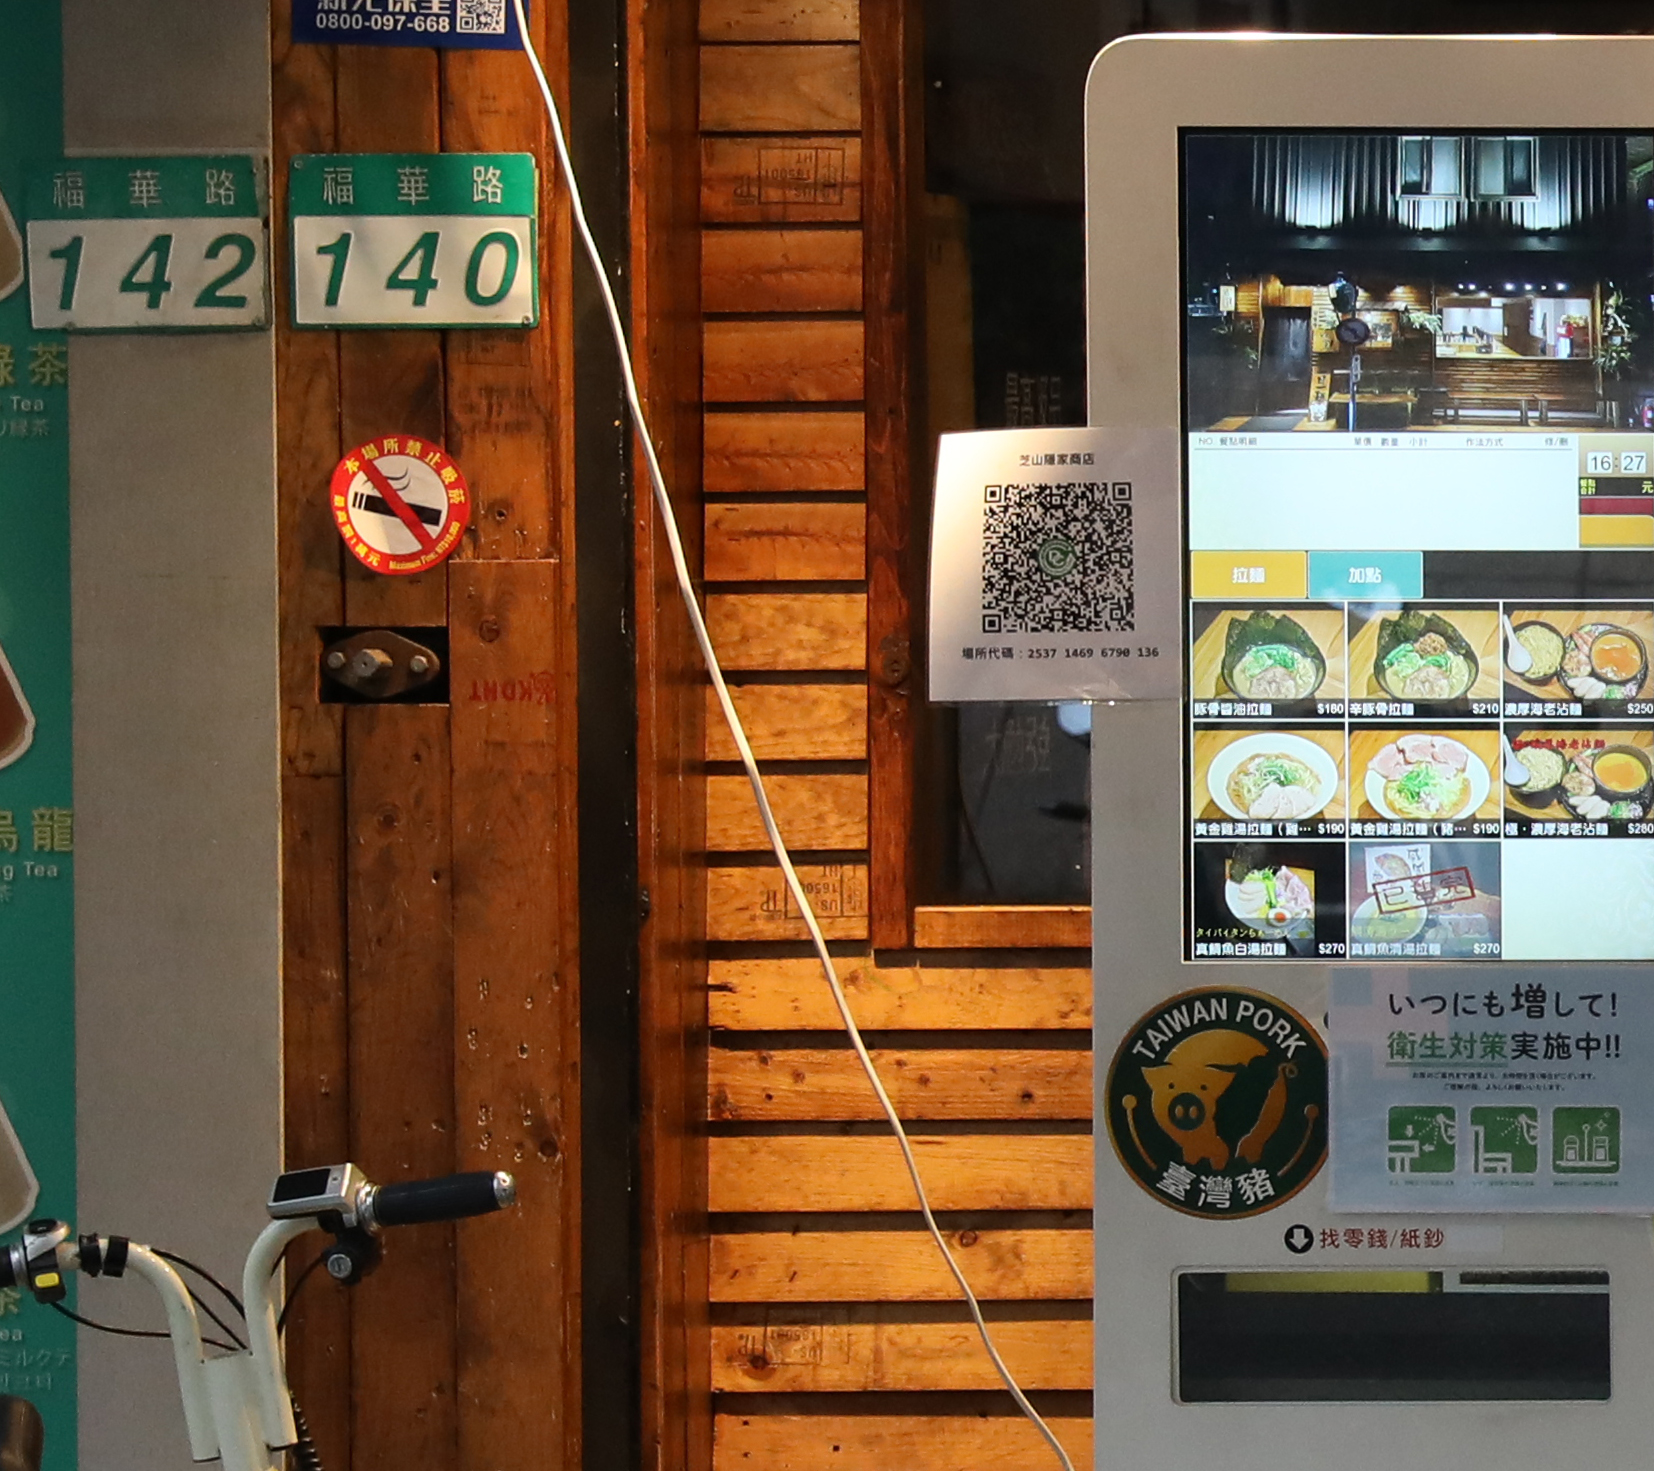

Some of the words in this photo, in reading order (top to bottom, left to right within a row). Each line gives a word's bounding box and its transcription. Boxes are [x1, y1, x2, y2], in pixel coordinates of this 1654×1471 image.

[315, 13, 450, 33] 0800-097-668
[53, 171, 237, 208] 福華路
[321, 165, 504, 206] 福華路
[48, 232, 257, 311] 142
[315, 231, 521, 308] 140
[10, 394, 45, 412] Tea
[1641, 480, 1654, 495] 元
[1348, 566, 1383, 584] 加點
[1027, 647, 1057, 659] 2537
[1064, 647, 1094, 658] 1469
[1100, 647, 1131, 658] 6790
[1137, 646, 1160, 658] 136
[1472, 702, 1499, 715] $210
[1627, 702, 1654, 715] $250
[1317, 823, 1345, 835] $190
[1472, 823, 1500, 835] $190
[23, 862, 58, 879] Tea
[1318, 942, 1346, 955] $270
[1472, 942, 1501, 955] $270
[1132, 997, 1228, 1060] TAIWAN
[1235, 999, 1308, 1060] PORK
[1155, 1160, 1276, 1210] 臺灣豬
[1318, 1227, 1445, 1250] 找零錢/紙鈔
